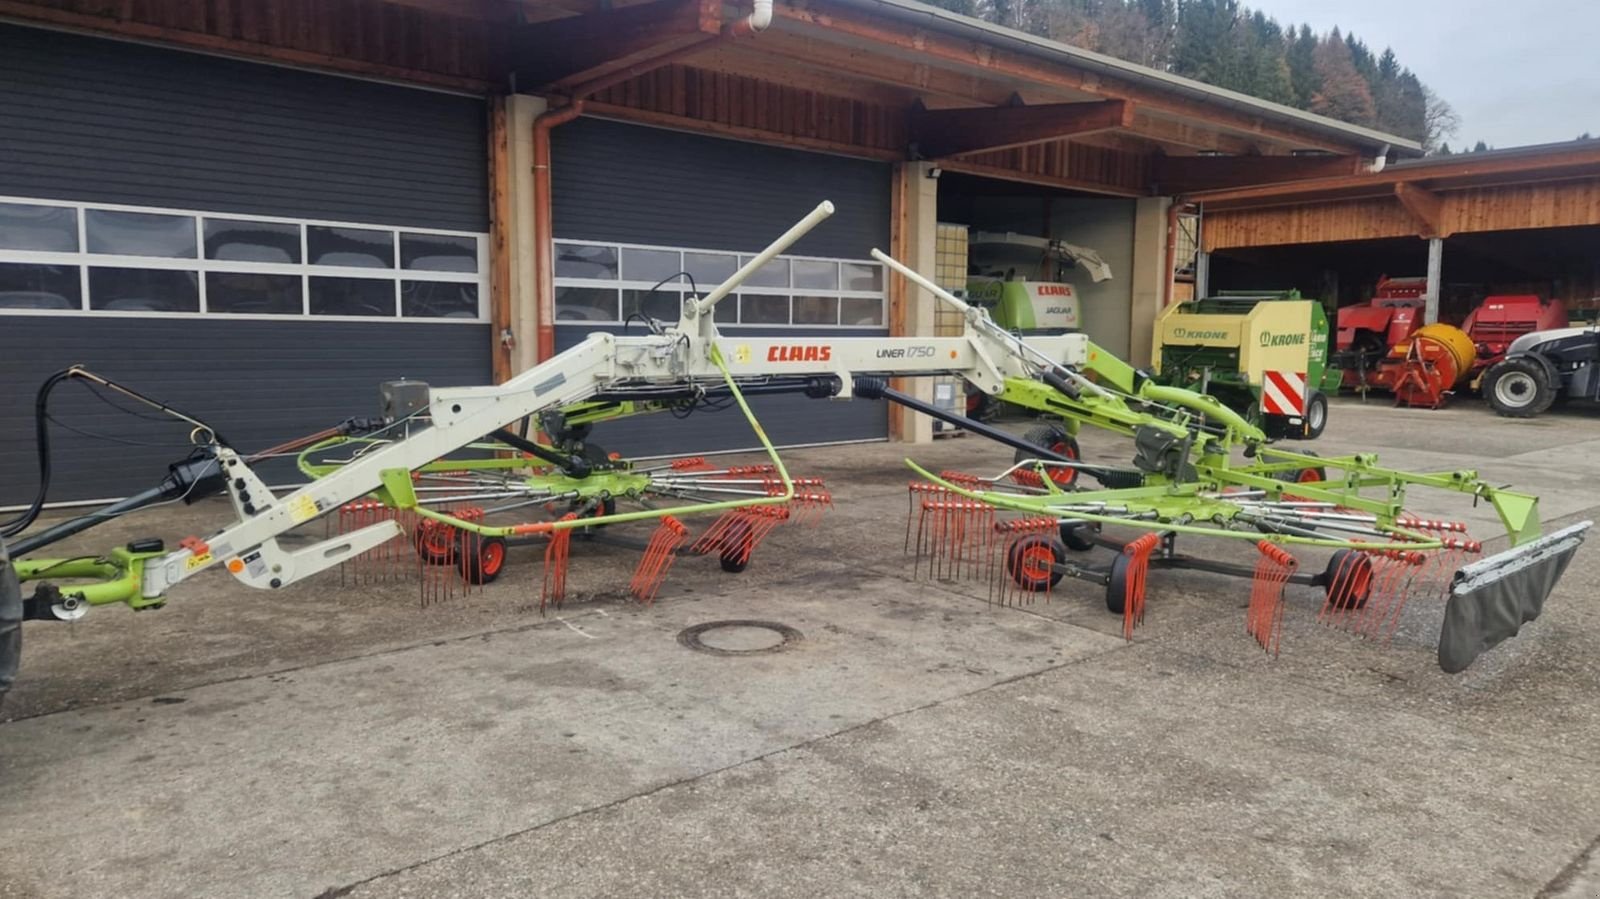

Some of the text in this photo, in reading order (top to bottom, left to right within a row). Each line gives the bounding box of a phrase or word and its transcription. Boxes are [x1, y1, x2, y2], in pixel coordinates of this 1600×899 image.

[1037, 285, 1072, 297] CLAAS
[1045, 306, 1071, 314] JAGUAR
[1186, 330, 1228, 340] KRONE
[1270, 333, 1305, 346] KRONE
[767, 346, 831, 362] CLAAS
[876, 346, 935, 358] LINER 1750
